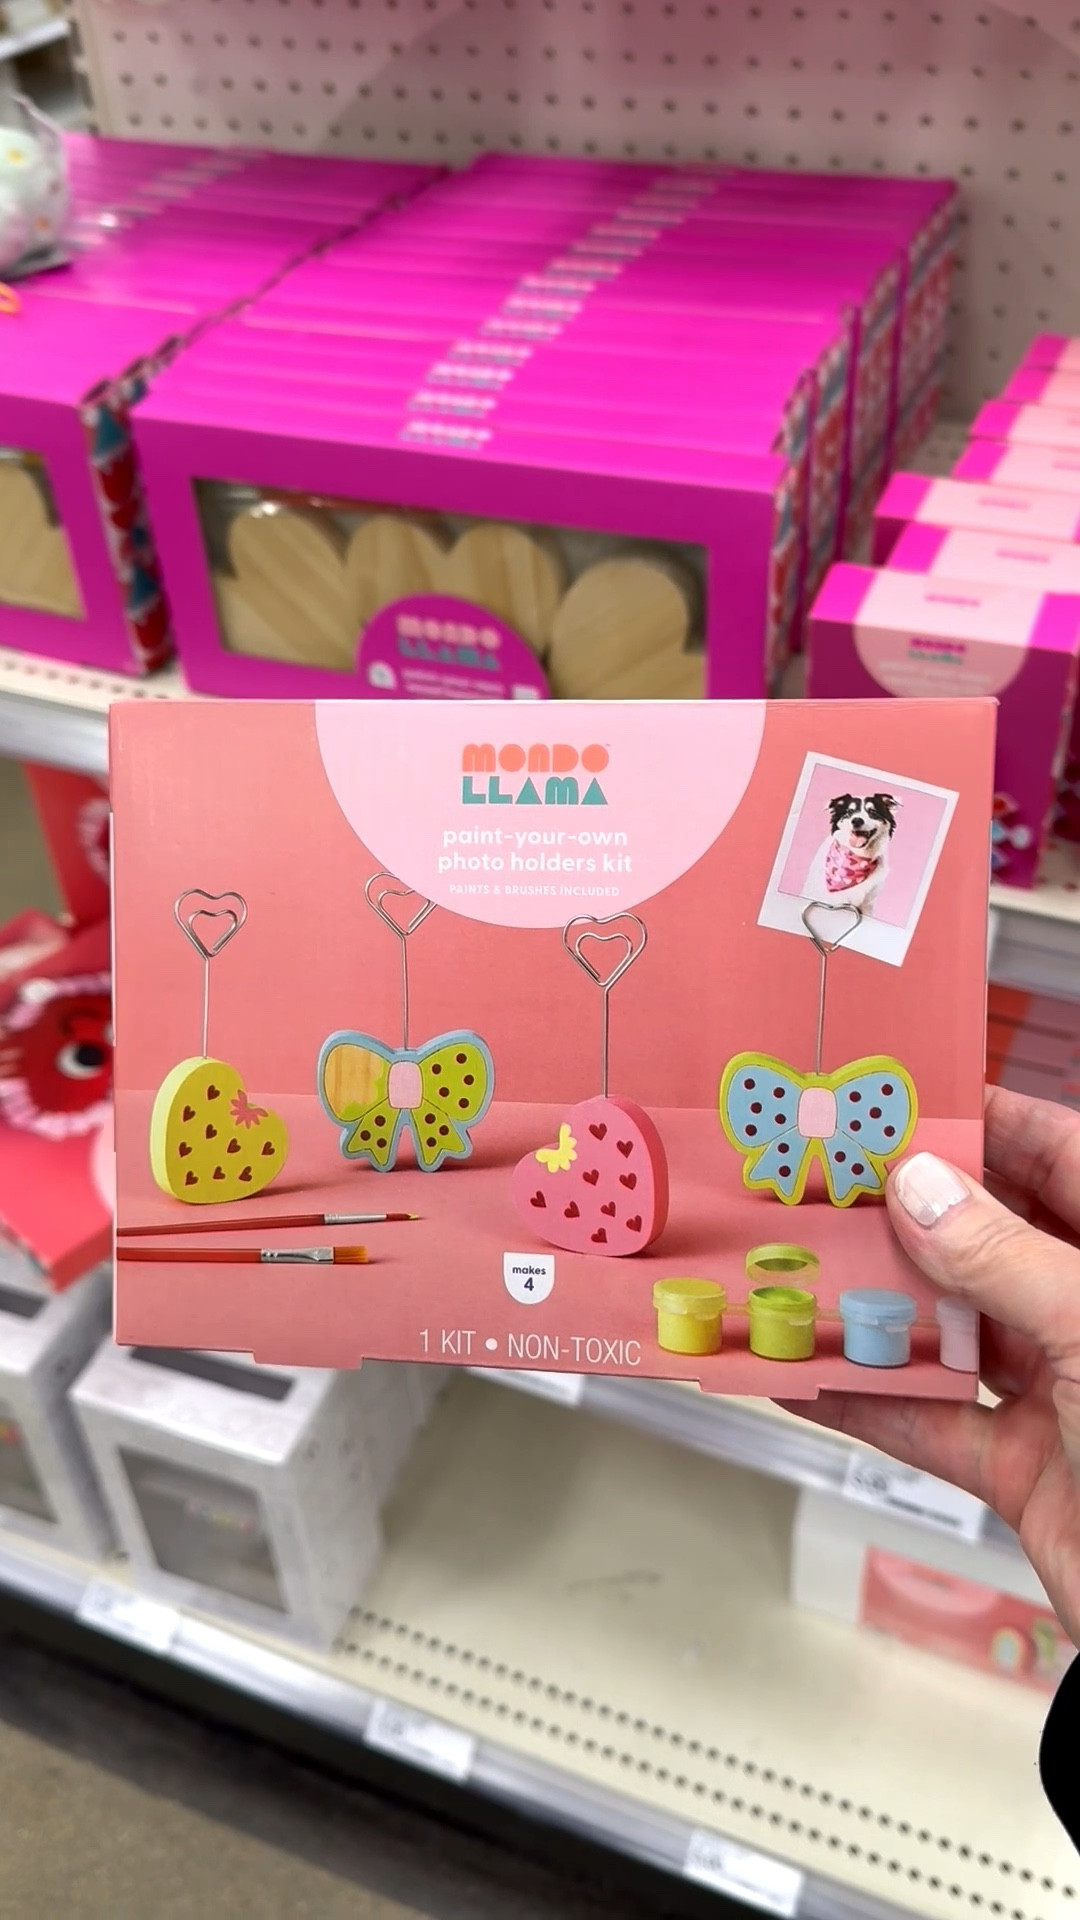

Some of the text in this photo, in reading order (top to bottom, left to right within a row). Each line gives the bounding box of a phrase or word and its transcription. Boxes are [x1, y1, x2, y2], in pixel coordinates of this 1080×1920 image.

[462, 743, 609, 772] MONDO
[462, 776, 608, 805] LLAMA
[442, 826, 628, 848] paint-your-own
[438, 853, 632, 873] photo holders kit
[450, 884, 620, 897] PAINTS & BRUSHES INCLUDED
[512, 1265, 546, 1276] makes
[524, 1277, 534, 1291] 4
[420, 1329, 641, 1365] 1 KIT NON-TOXIC
